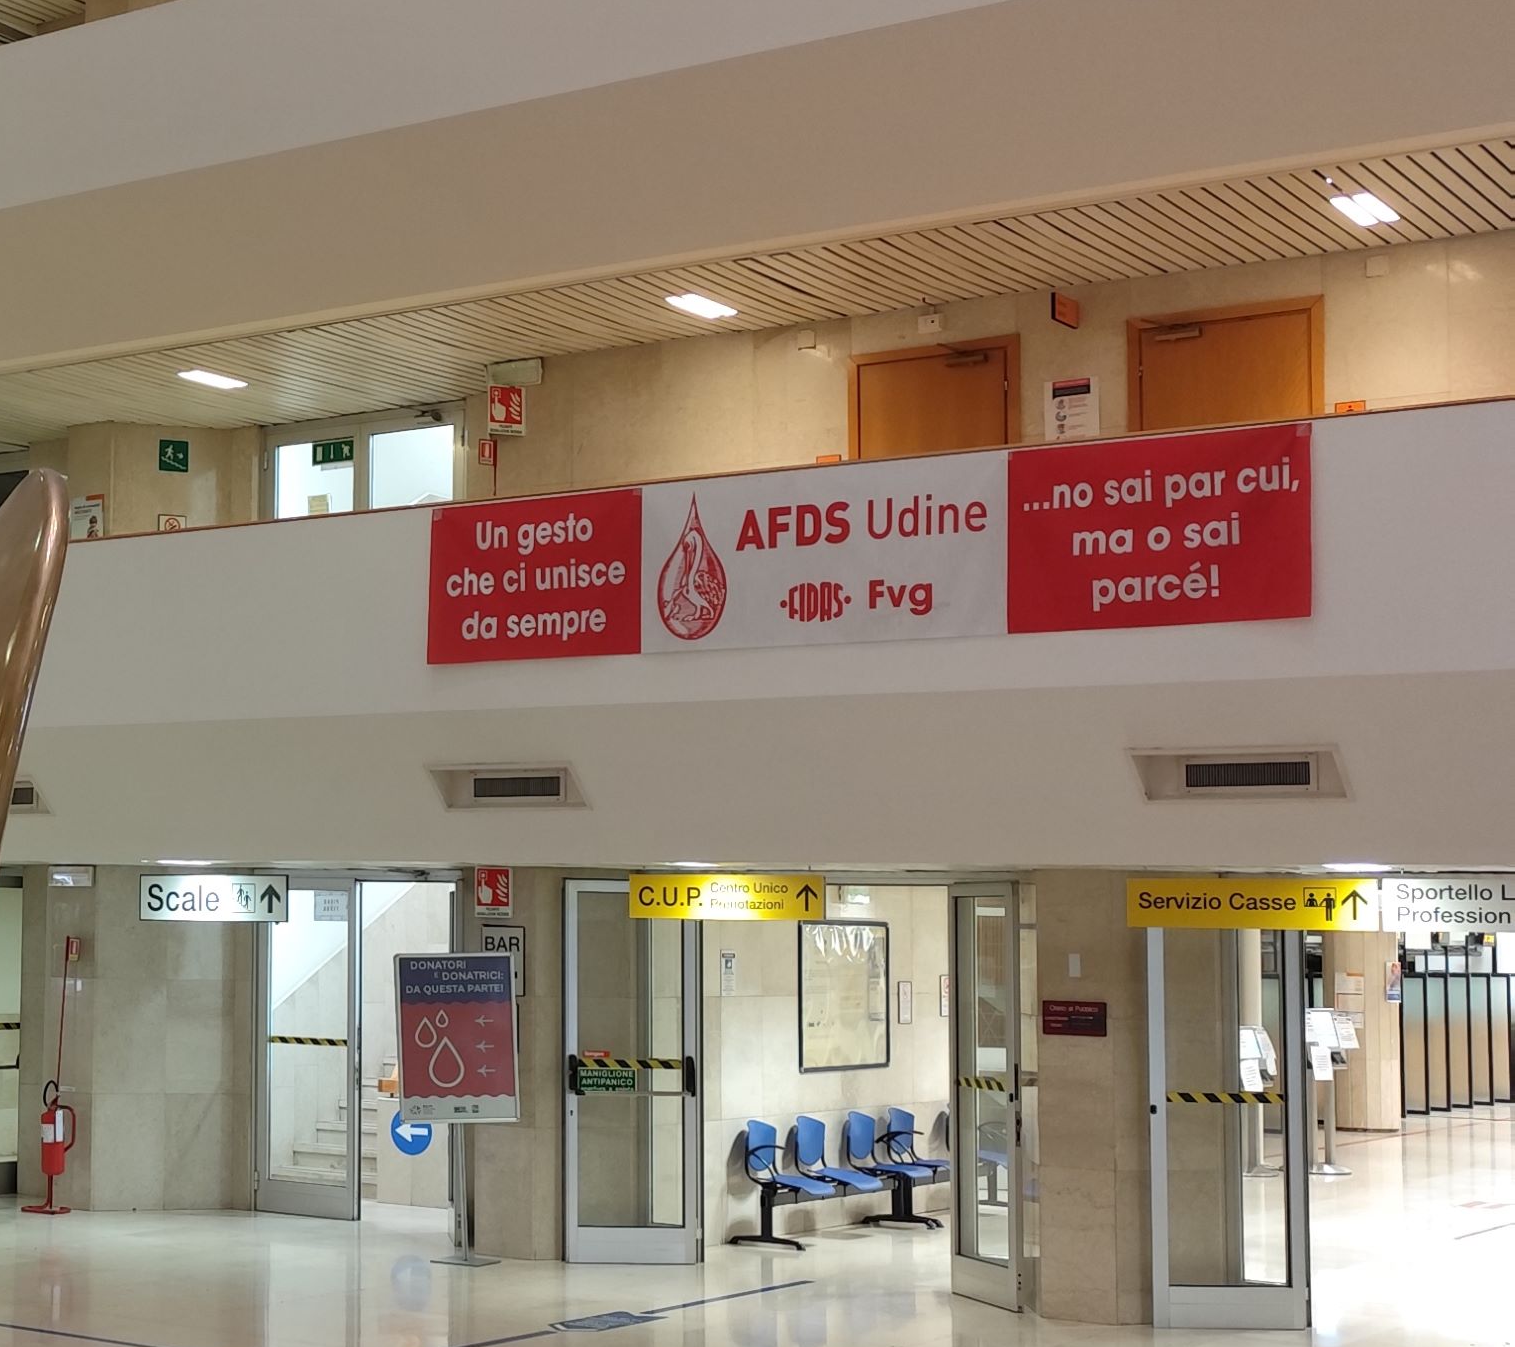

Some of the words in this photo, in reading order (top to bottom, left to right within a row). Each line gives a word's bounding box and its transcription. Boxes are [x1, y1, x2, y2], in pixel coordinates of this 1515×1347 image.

[1104, 469, 1153, 506] sai
[1164, 469, 1227, 508] par
[1236, 456, 1301, 493] cui,
[735, 501, 851, 552] AFDS
[867, 494, 988, 539] Udine
[475, 520, 509, 551] Un
[517, 512, 594, 555] gesto
[1072, 528, 1134, 556] ma
[1147, 525, 1172, 552] o
[1183, 512, 1241, 549] sai
[446, 567, 495, 597] che
[502, 562, 526, 594] ci
[535, 558, 626, 590] unisce
[1092, 561, 1220, 612] parcé!
[868, 579, 933, 616] Fvg
[461, 611, 498, 641] da
[506, 607, 607, 642] sempre
[147, 883, 220, 912] Scale
[638, 886, 703, 907] C.U.P.
[710, 882, 750, 894] Centro
[753, 883, 789, 894] Unico
[1396, 883, 1493, 903] Sportello
[1501, 884, 1515, 901] L
[1138, 891, 1222, 911] Servizio
[1229, 892, 1297, 911] Casse
[1397, 906, 1511, 924] Profession
[484, 936, 520, 953] BAR
[410, 960, 467, 971] DONATORI
[442, 971, 504, 981] DONATRICI:
[406, 985, 421, 994] DA
[423, 984, 466, 995] QUESTA
[579, 1069, 634, 1078] MANIGLIONE
[581, 1077, 633, 1086] ANTIPANICO
